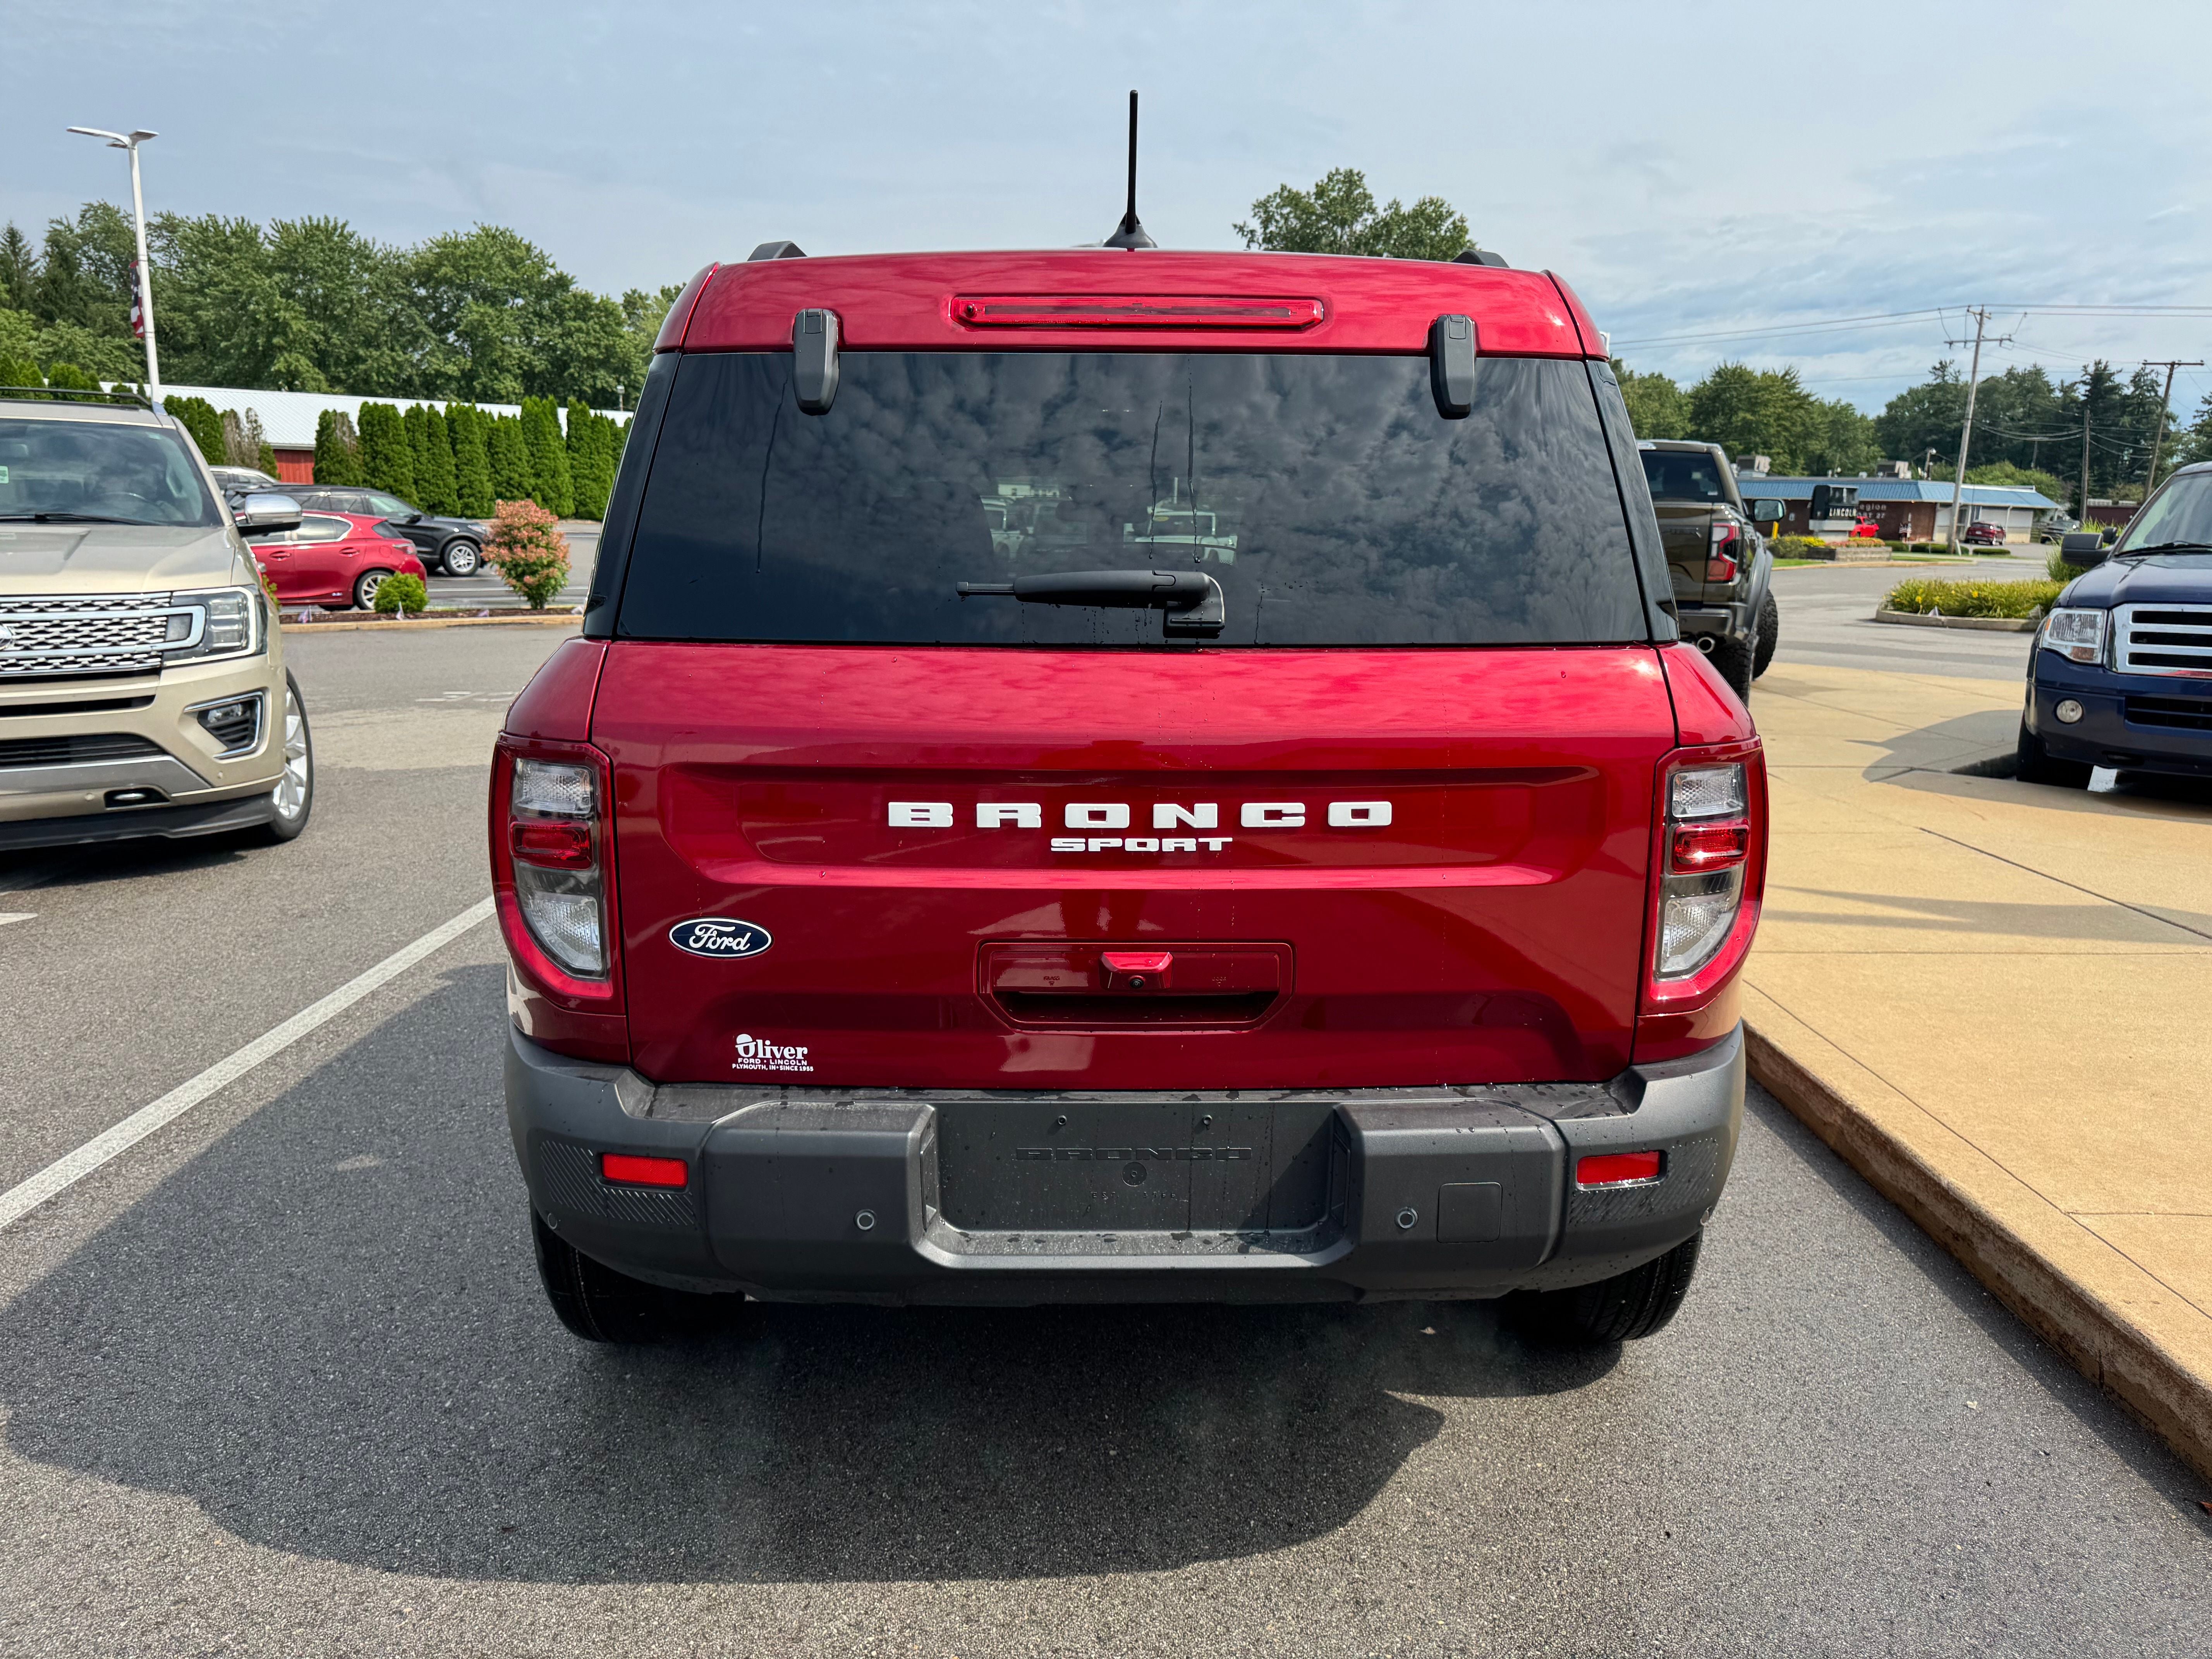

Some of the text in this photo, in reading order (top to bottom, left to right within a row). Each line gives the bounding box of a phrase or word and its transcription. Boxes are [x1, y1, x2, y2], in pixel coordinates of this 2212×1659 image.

[1829, 508, 1856, 517] LINCOLN
[1859, 503, 1887, 512] egion
[888, 801, 1392, 828] BRONCO
[1051, 837, 1233, 852] SPORT
[689, 924, 751, 950] Ford
[735, 1039, 808, 1059] Oliver
[1017, 1147, 1252, 1160] BRONCO
